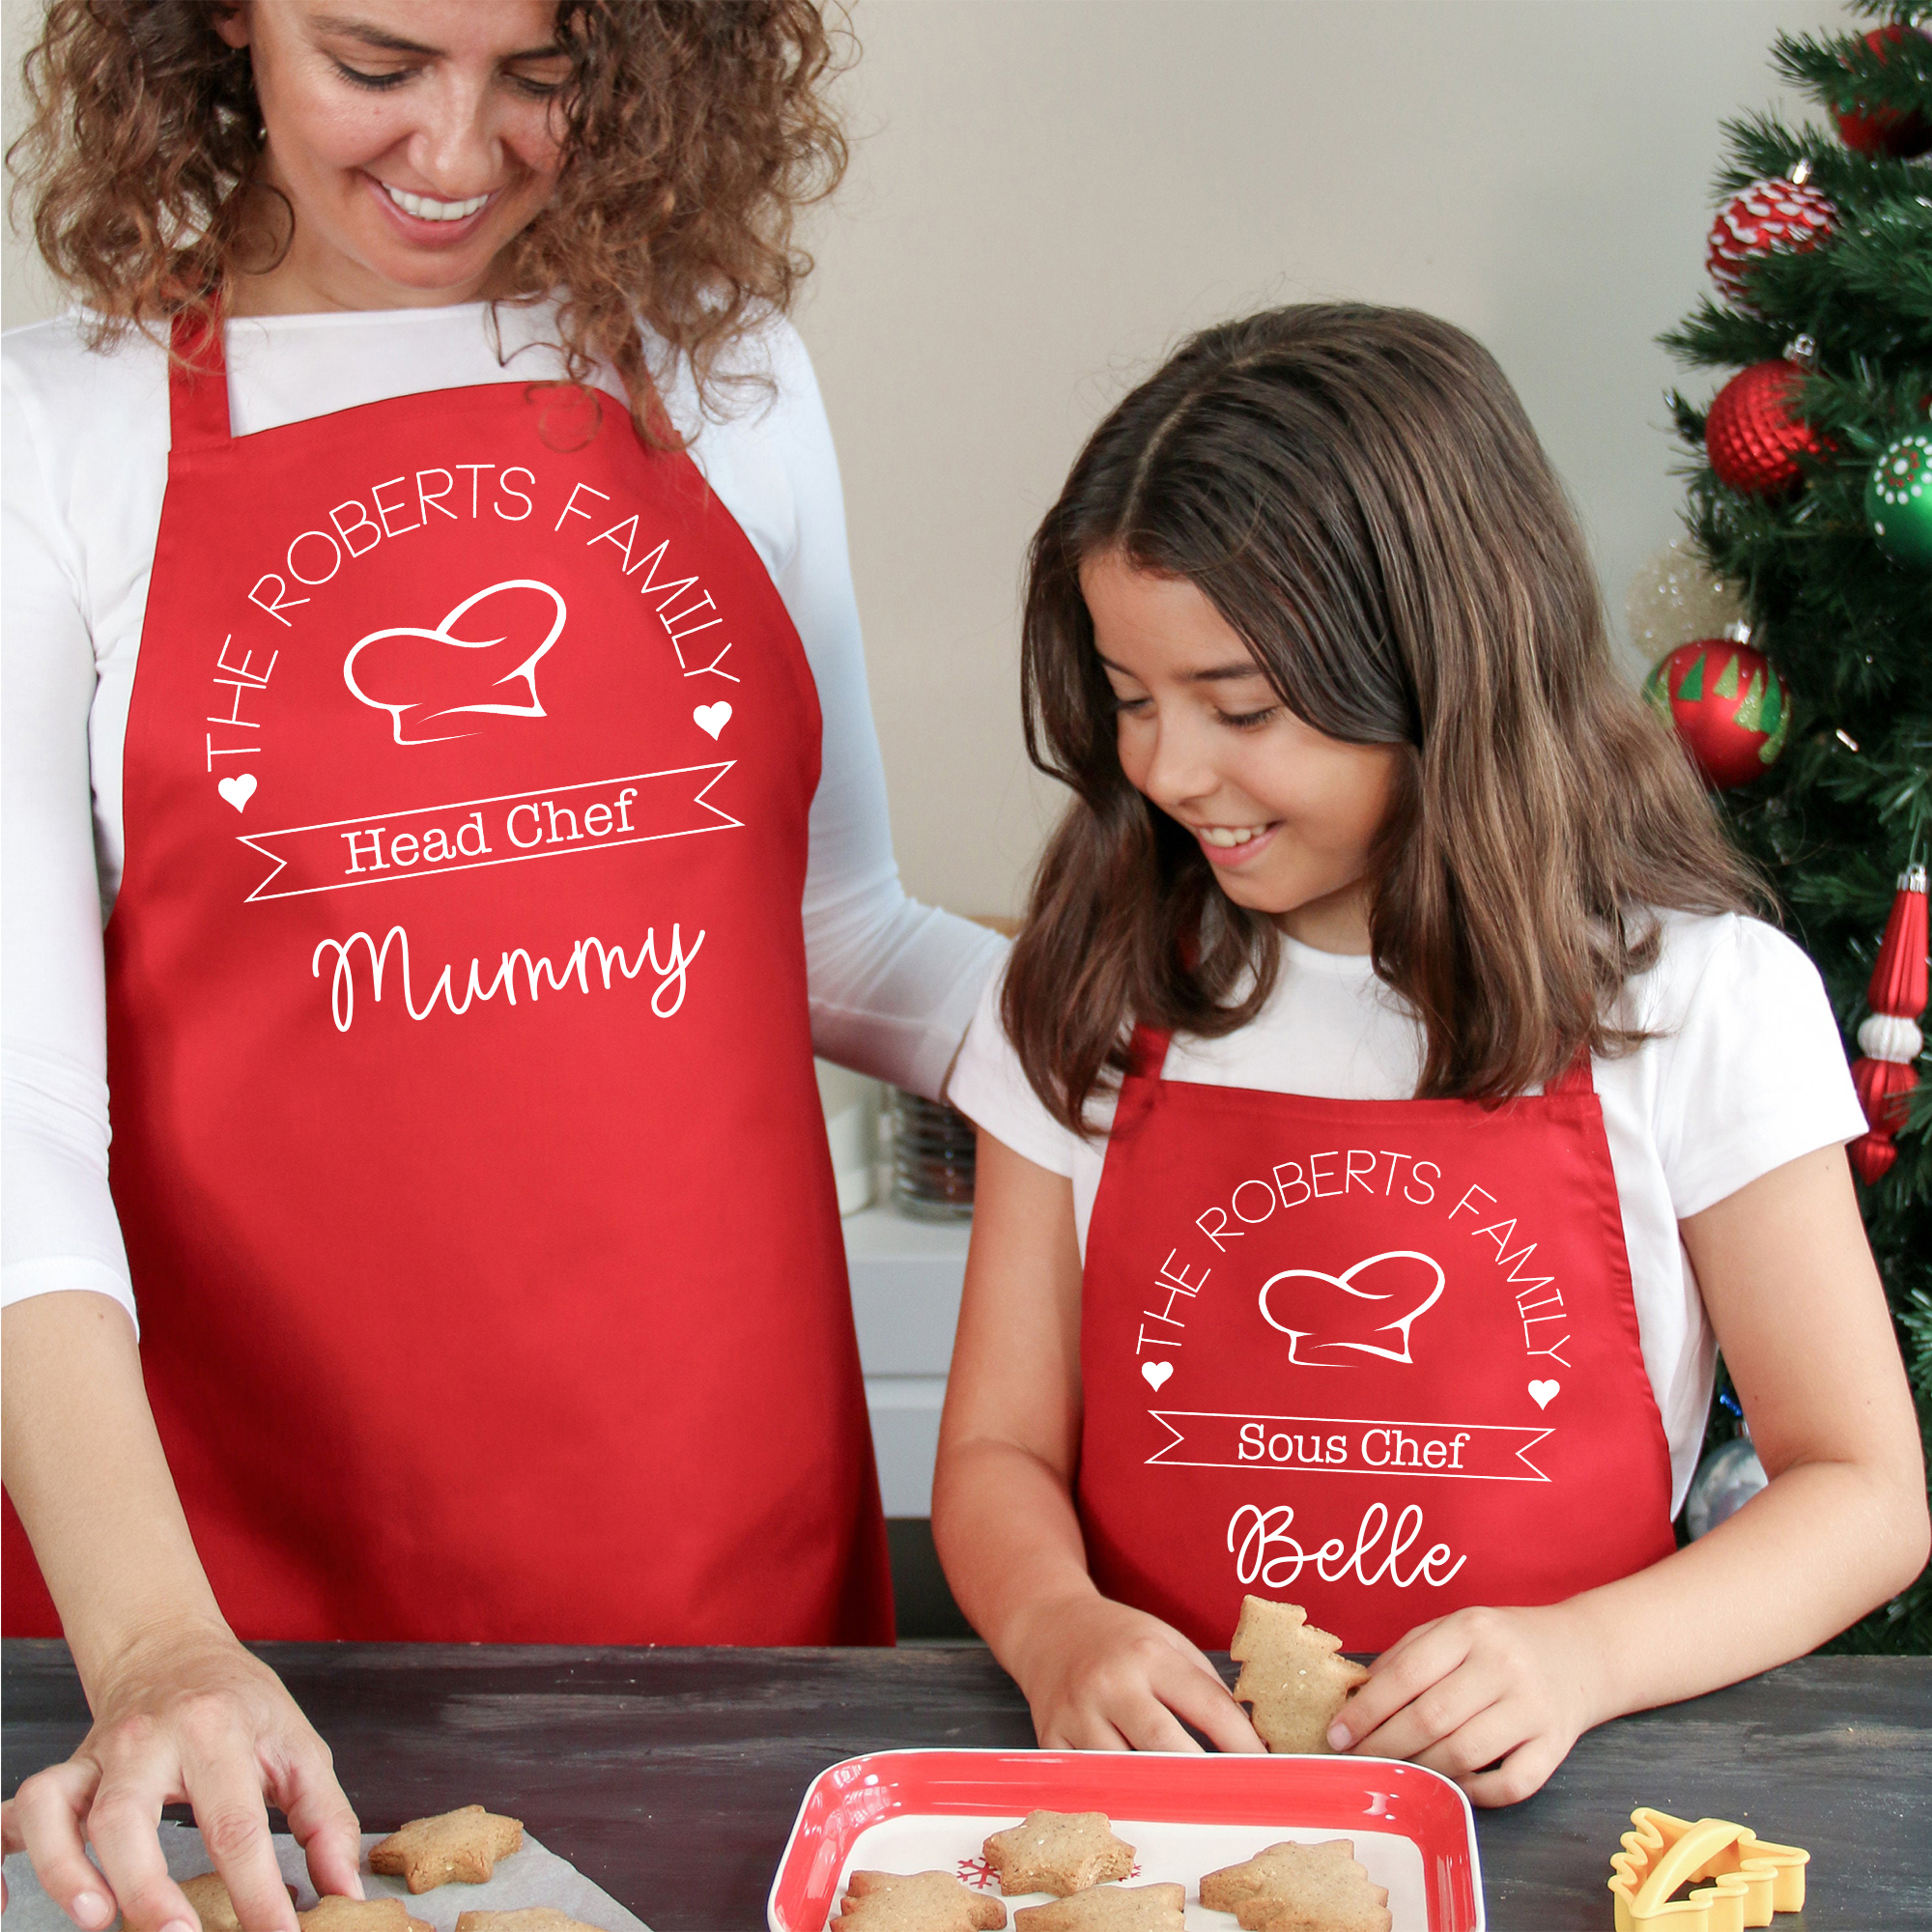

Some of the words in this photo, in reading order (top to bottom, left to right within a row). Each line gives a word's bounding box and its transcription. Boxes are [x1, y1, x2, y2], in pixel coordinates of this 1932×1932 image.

[206, 633, 279, 773] THE
[247, 464, 536, 628] ROBERTS
[554, 482, 741, 683] FAMILY
[340, 811, 493, 875] Head
[506, 787, 639, 848] Chef
[312, 923, 706, 1033] Mummy
[1135, 1247, 1211, 1355] THE
[1195, 1150, 1441, 1253] ROBERTS
[1447, 1183, 1572, 1368] FAMILY
[1237, 1423, 1349, 1463] Sous
[1361, 1429, 1471, 1469] Chef
[1227, 1502, 1467, 1588] Belle
